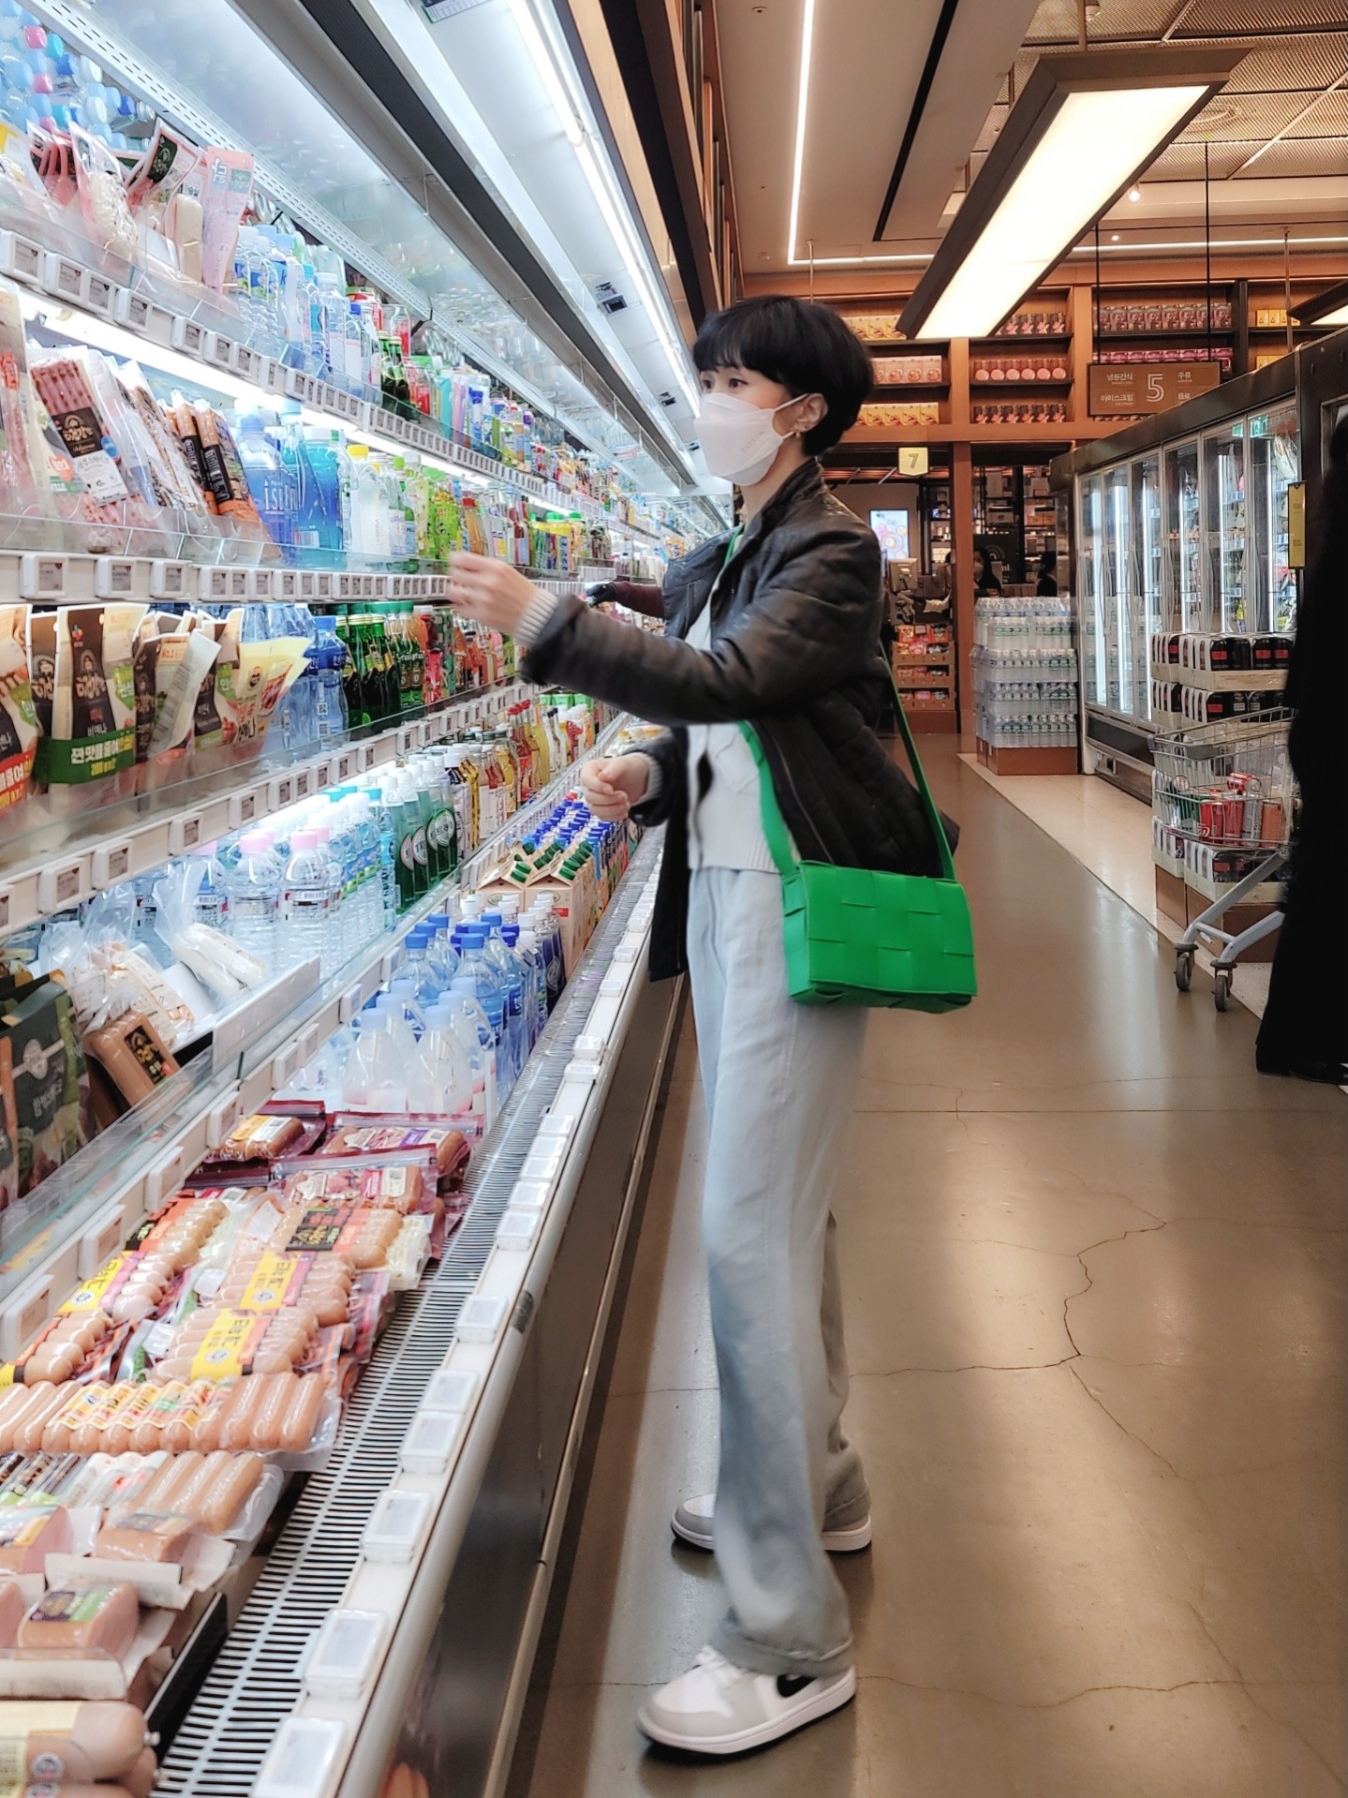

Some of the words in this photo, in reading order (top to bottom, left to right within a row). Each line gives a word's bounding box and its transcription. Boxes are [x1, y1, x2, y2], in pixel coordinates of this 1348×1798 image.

[1146, 373, 1165, 403] 5
[1100, 393, 1134, 402] 아이스크림
[908, 452, 920, 470] 7
